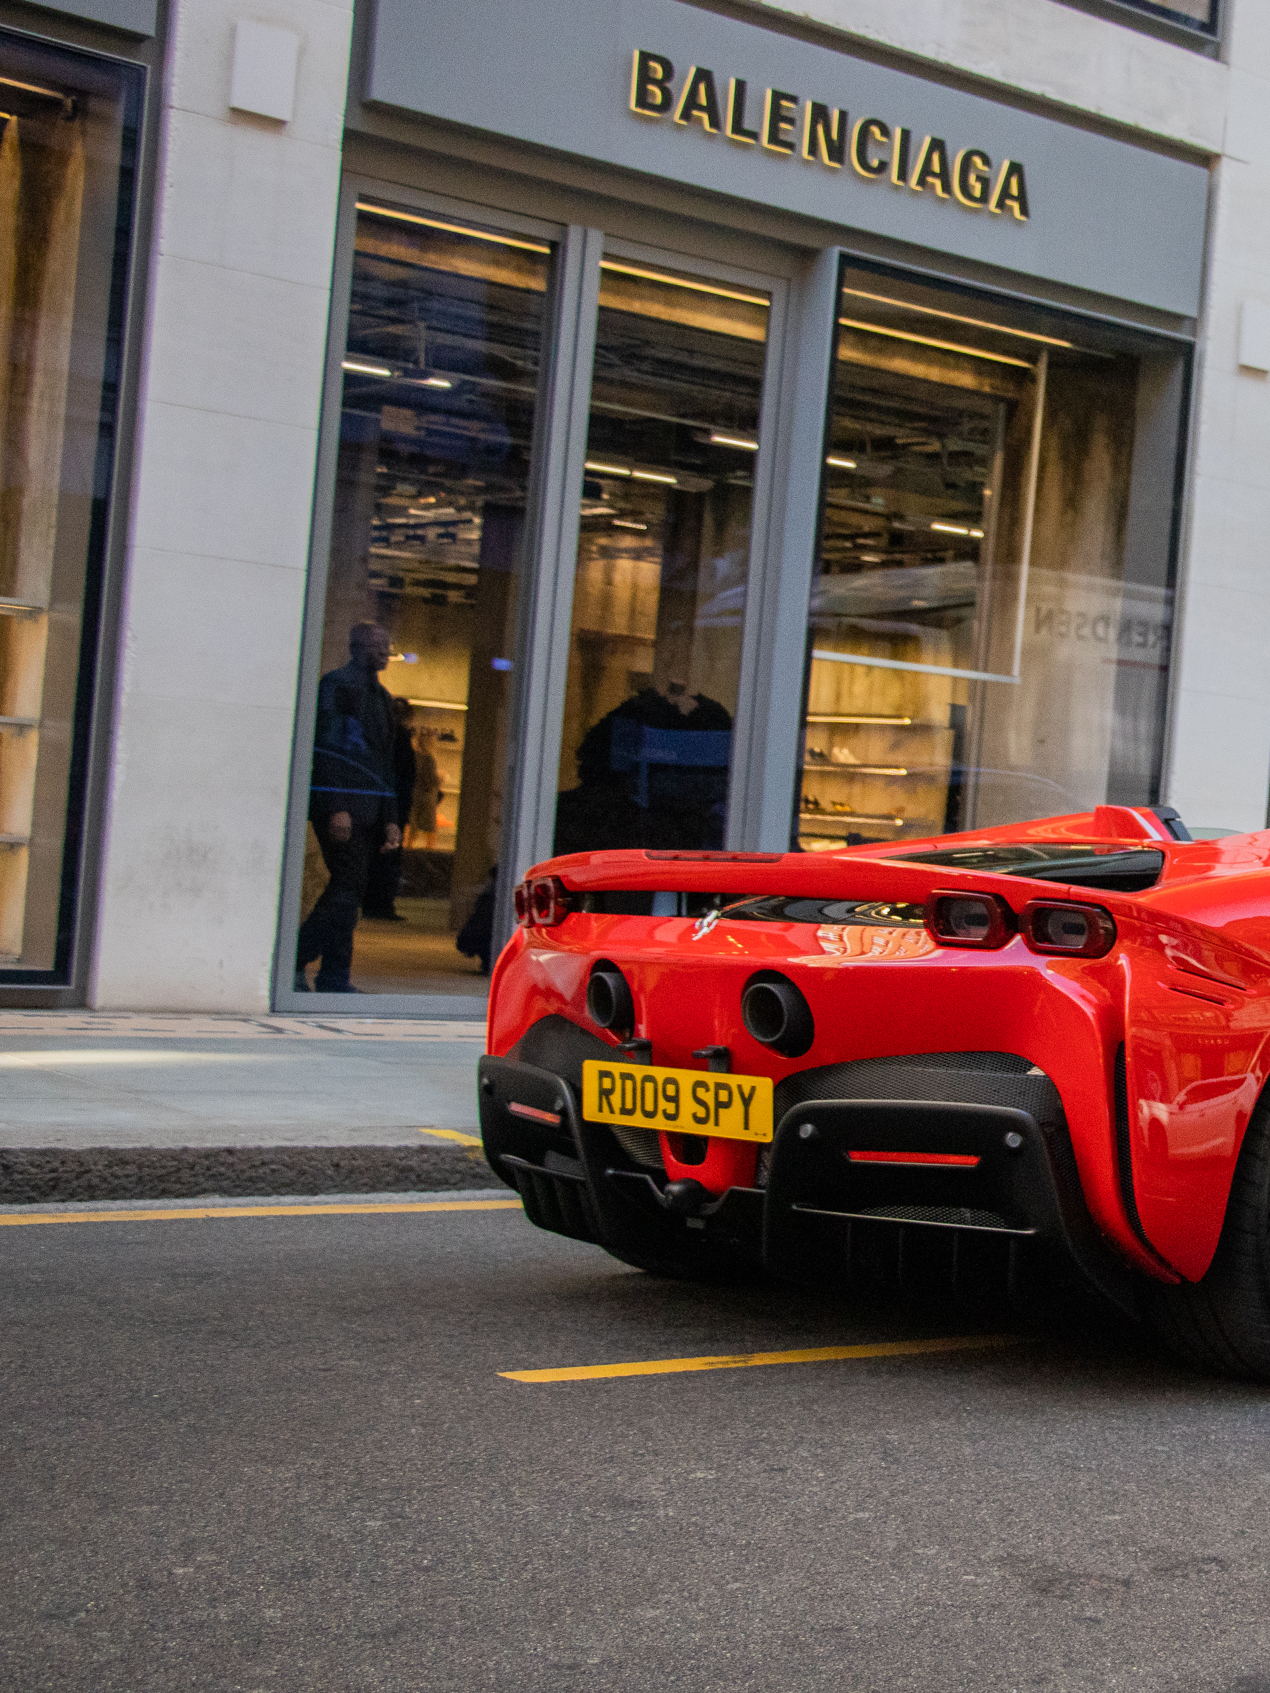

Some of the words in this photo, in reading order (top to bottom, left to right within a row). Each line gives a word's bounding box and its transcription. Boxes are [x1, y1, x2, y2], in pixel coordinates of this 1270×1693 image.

[630, 49, 1030, 221] BALENCIAGA
[598, 1069, 680, 1122] RD09
[691, 1079, 757, 1131] SPY
